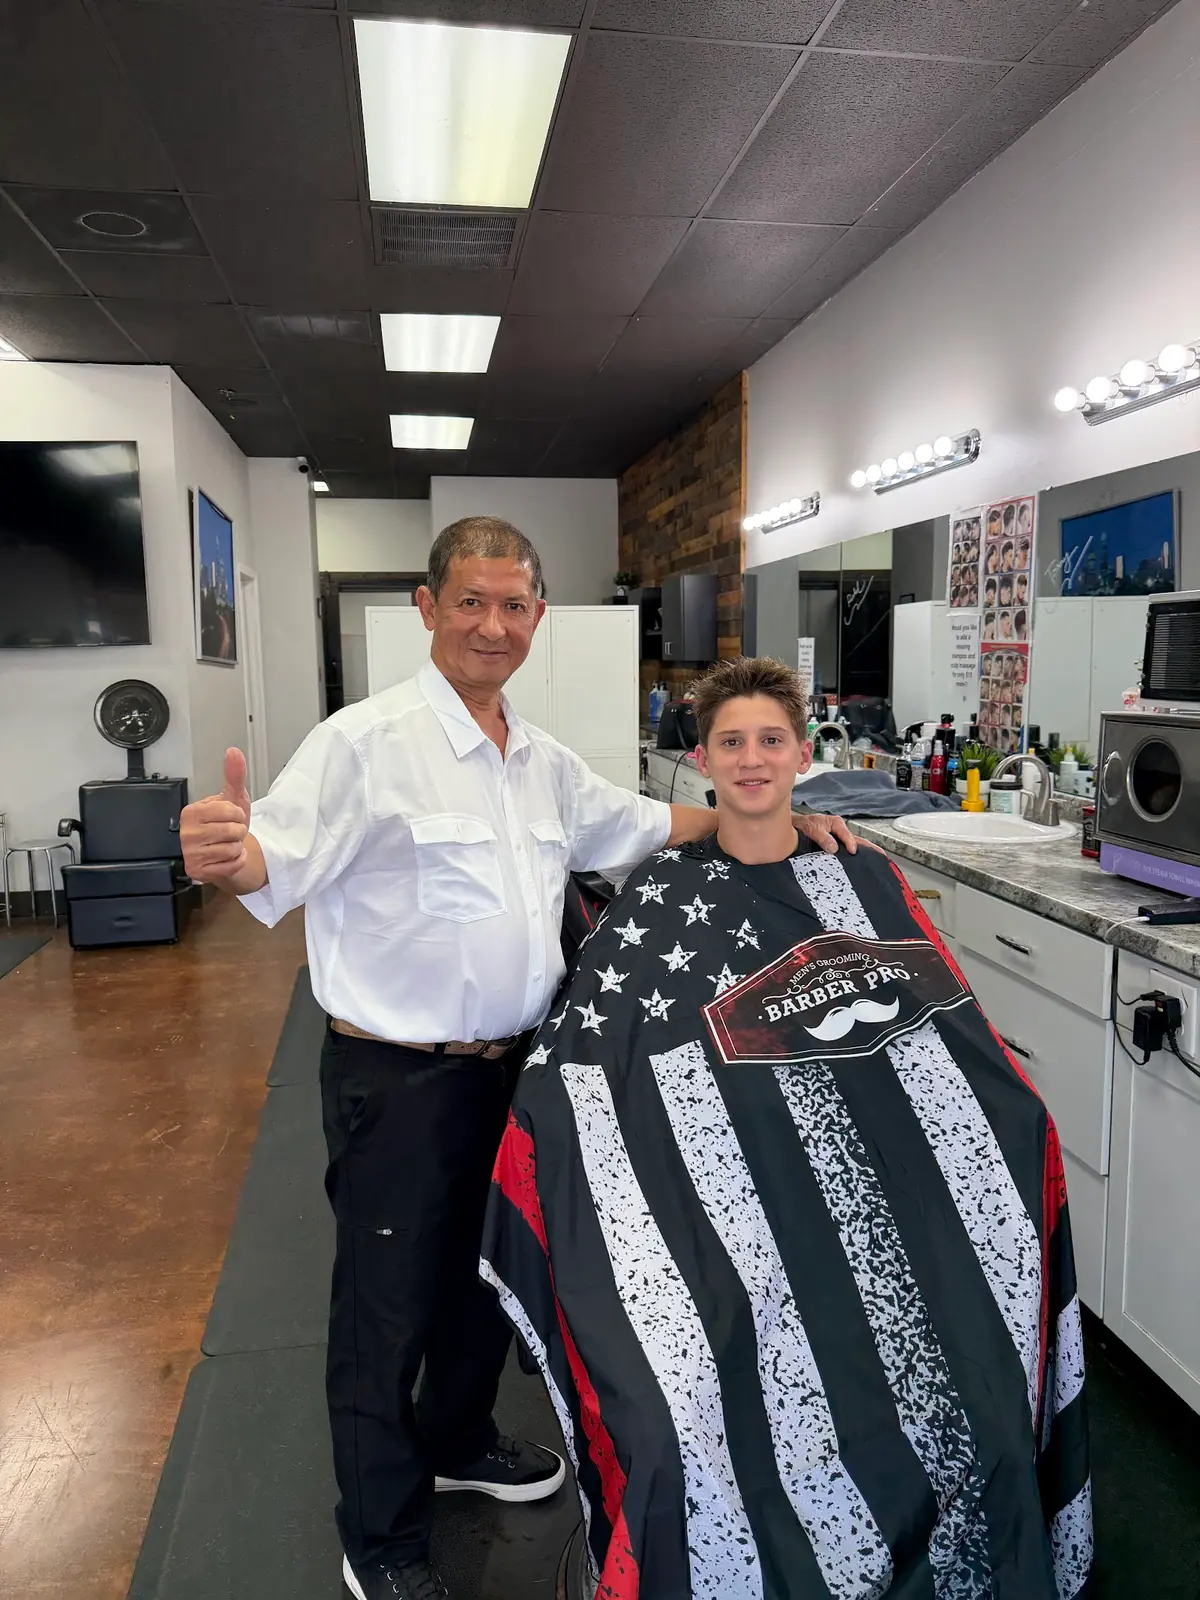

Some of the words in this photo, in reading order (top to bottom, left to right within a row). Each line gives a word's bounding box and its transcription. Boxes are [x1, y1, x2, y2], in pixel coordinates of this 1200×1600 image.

[789, 962, 816, 985] MEN'S
[816, 952, 870, 967] GROOMING
[764, 979, 860, 1022] BARBER
[863, 966, 911, 991] PRO
